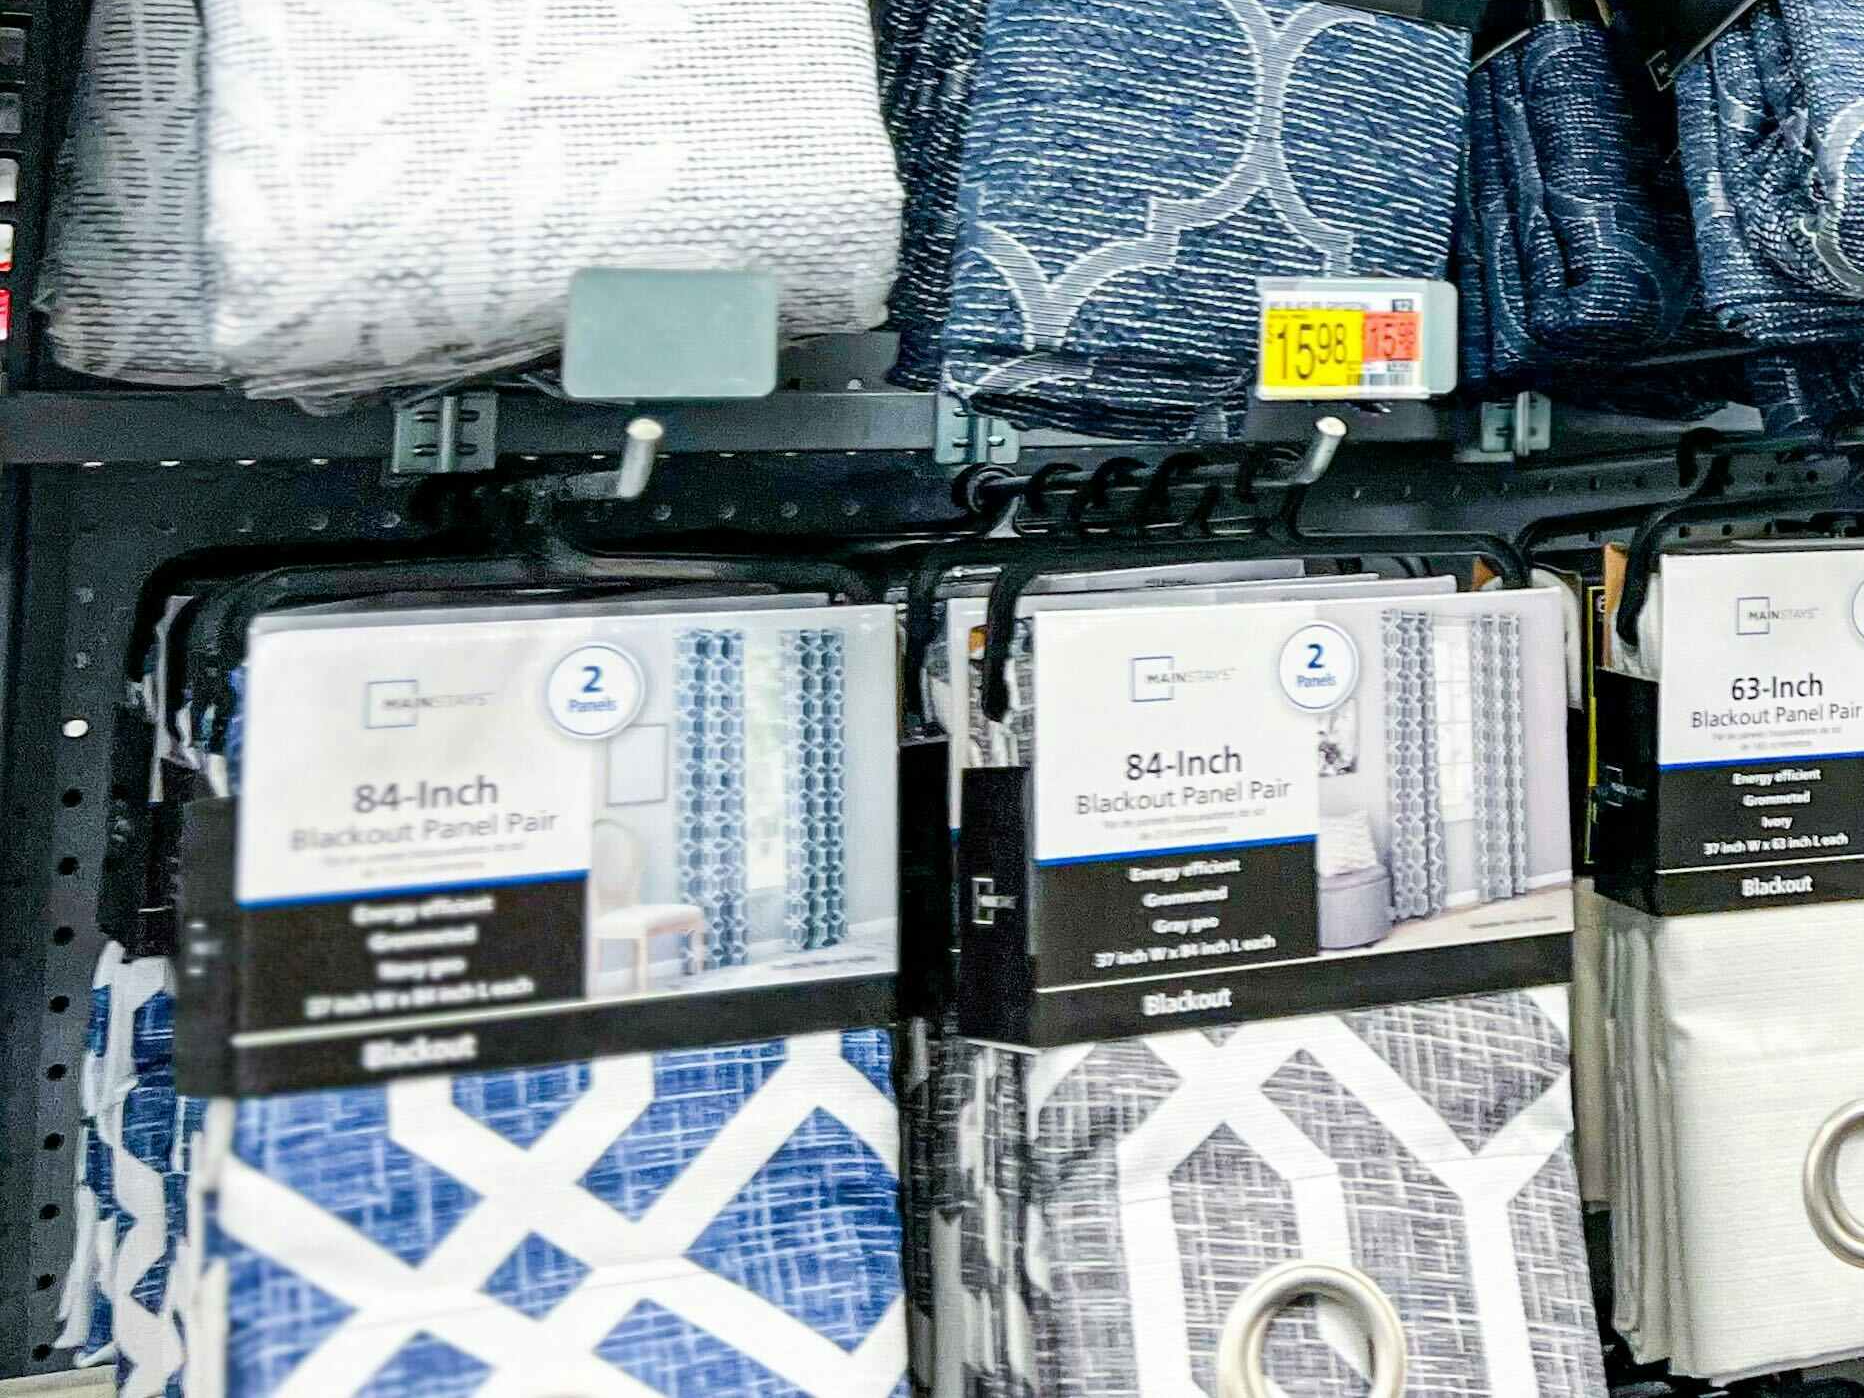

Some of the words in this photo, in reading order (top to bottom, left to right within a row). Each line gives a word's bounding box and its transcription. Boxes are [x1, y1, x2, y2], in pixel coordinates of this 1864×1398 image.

[1307, 643, 1325, 669] 2
[582, 666, 602, 693] 2
[1297, 674, 1336, 688] Panels
[1732, 672, 1823, 701] 63-Inch
[569, 698, 617, 712] Panels
[1692, 708, 1770, 728] Blackout
[1776, 703, 1824, 723] Panel
[1830, 702, 1862, 720] Pair
[1126, 745, 1242, 781] 84-Inch
[1732, 773, 1773, 786] Energy
[1774, 769, 1821, 783] efficient
[353, 775, 498, 813] 84-Inch
[1076, 790, 1177, 815] Blackout
[1182, 782, 1243, 806] Panel
[1250, 778, 1292, 800] Pair
[290, 823, 414, 851] Blackout
[422, 814, 497, 840] Panel
[506, 811, 559, 833] Pair
[1761, 816, 1793, 829] Ivory
[1703, 842, 1720, 855] 37
[1720, 840, 1746, 854] inch
[1746, 840, 1761, 852] W
[1761, 841, 1770, 851] x
[1787, 835, 1812, 849] inch
[1820, 832, 1849, 846] each
[1742, 875, 1813, 897] Blackout
[1142, 987, 1232, 1016] Blackout
[361, 1033, 478, 1070] Blackout
